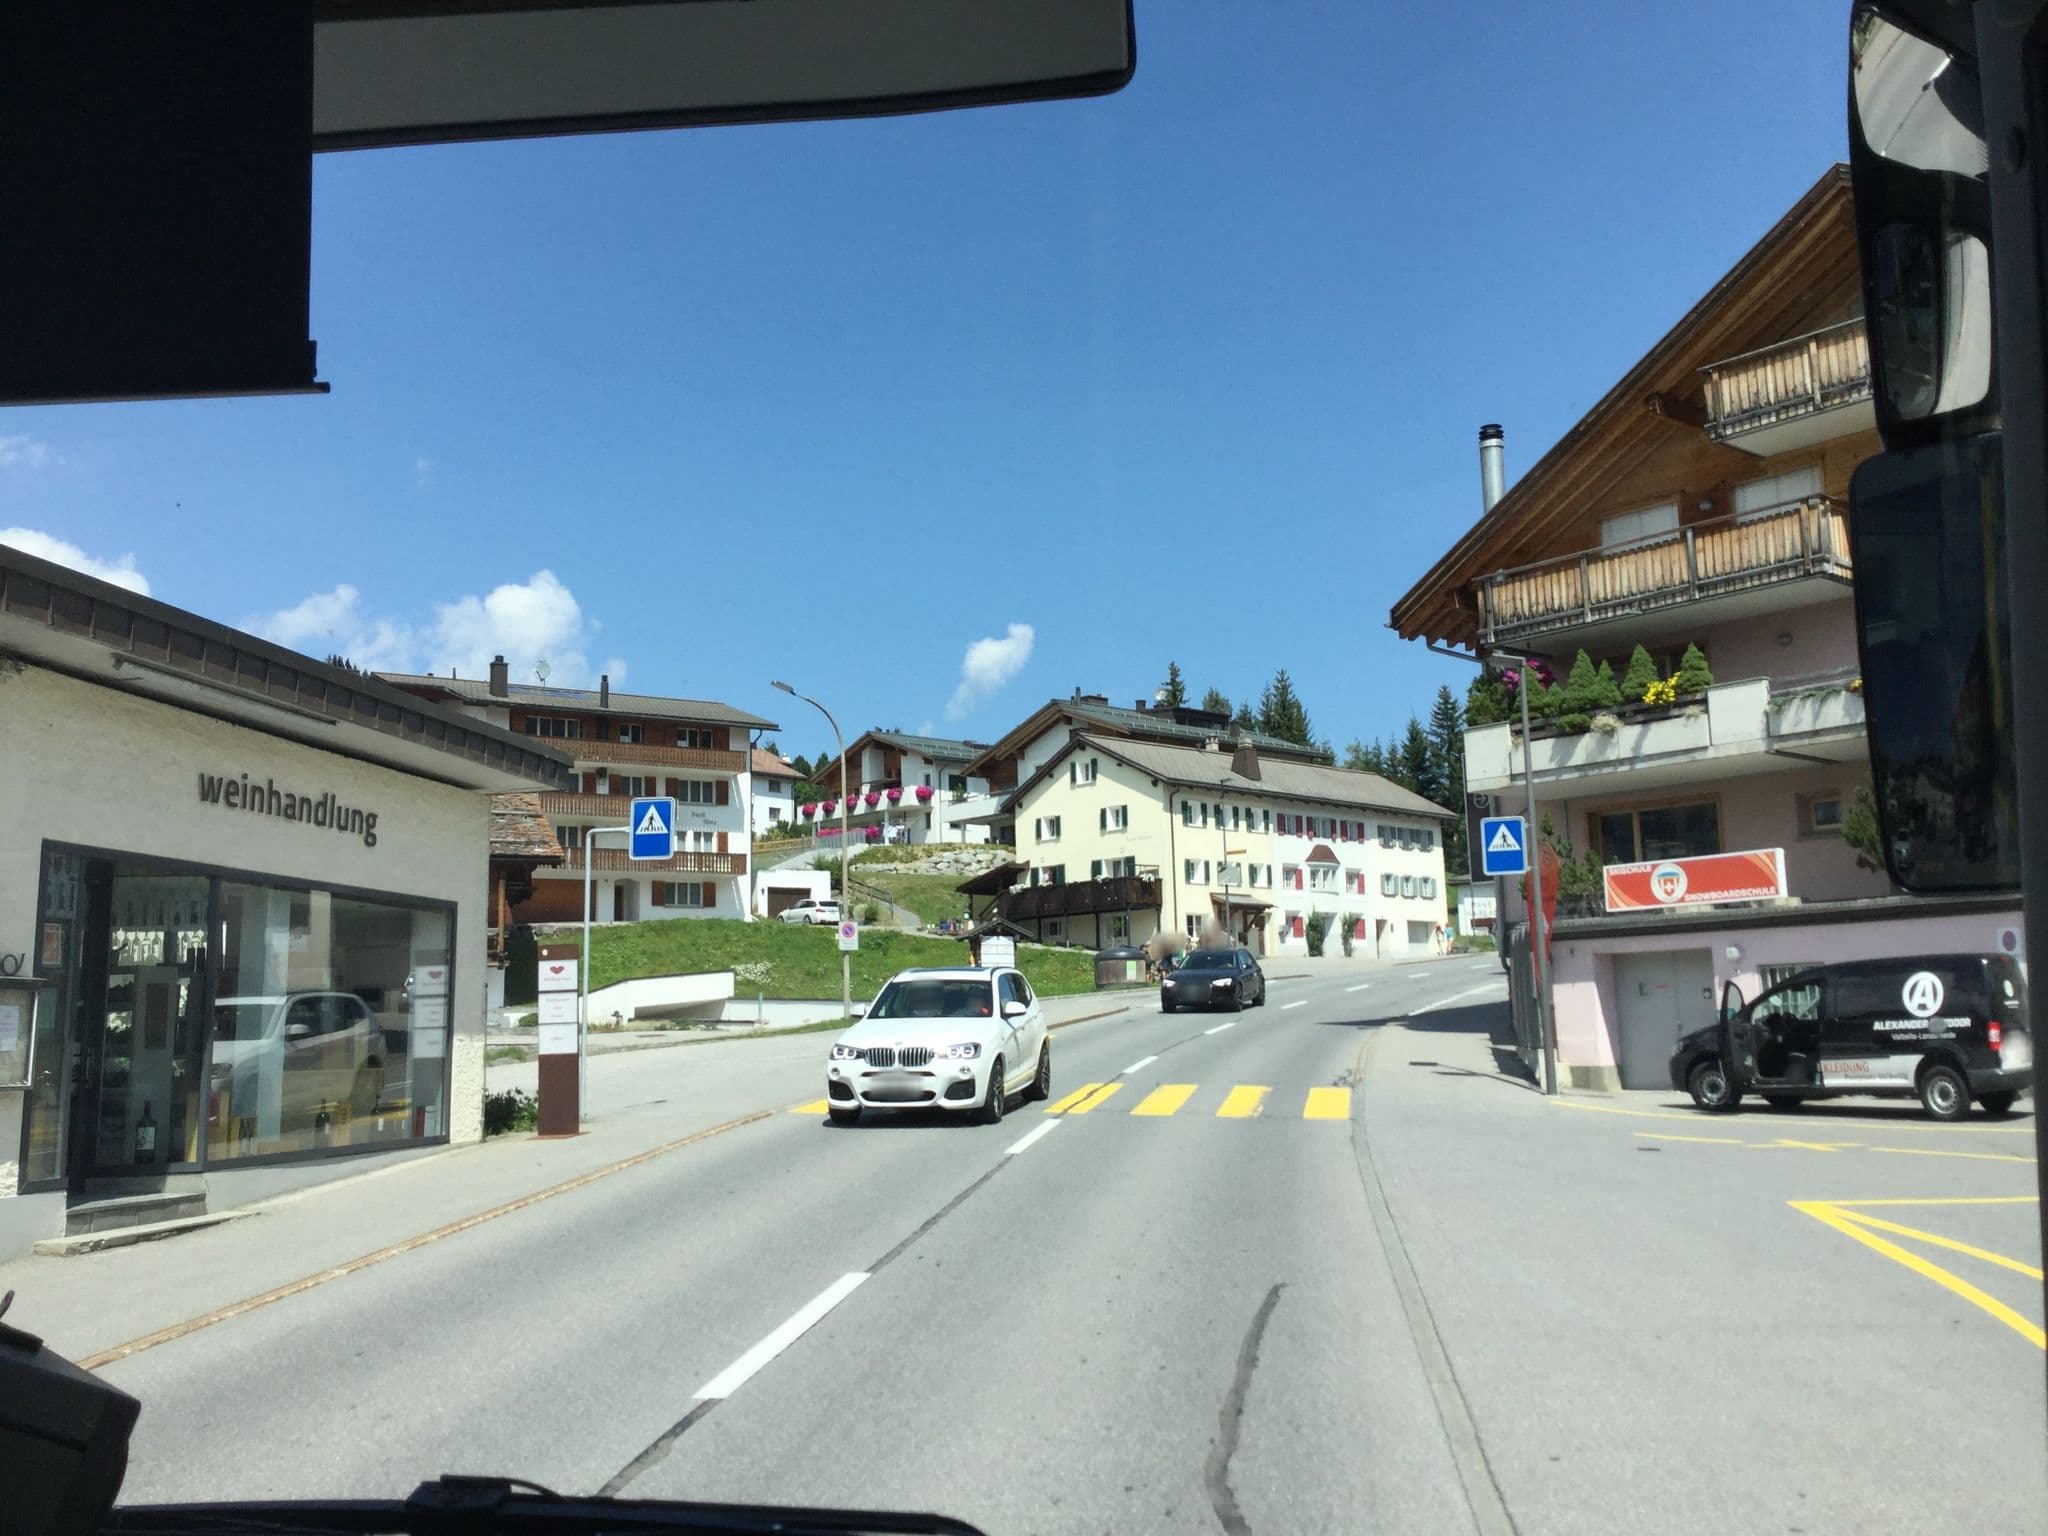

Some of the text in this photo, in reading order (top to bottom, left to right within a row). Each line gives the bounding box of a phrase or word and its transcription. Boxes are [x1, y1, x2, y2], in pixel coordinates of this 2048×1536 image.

[198, 772, 378, 847] weinhandlung
[1609, 864, 1652, 876] SKISCHULE
[1684, 886, 1776, 902] SNOWBOARDSCHULE
[1873, 1018, 1928, 1031] ALEXANDER
[1823, 1062, 1870, 1073] KLEIDUNG
